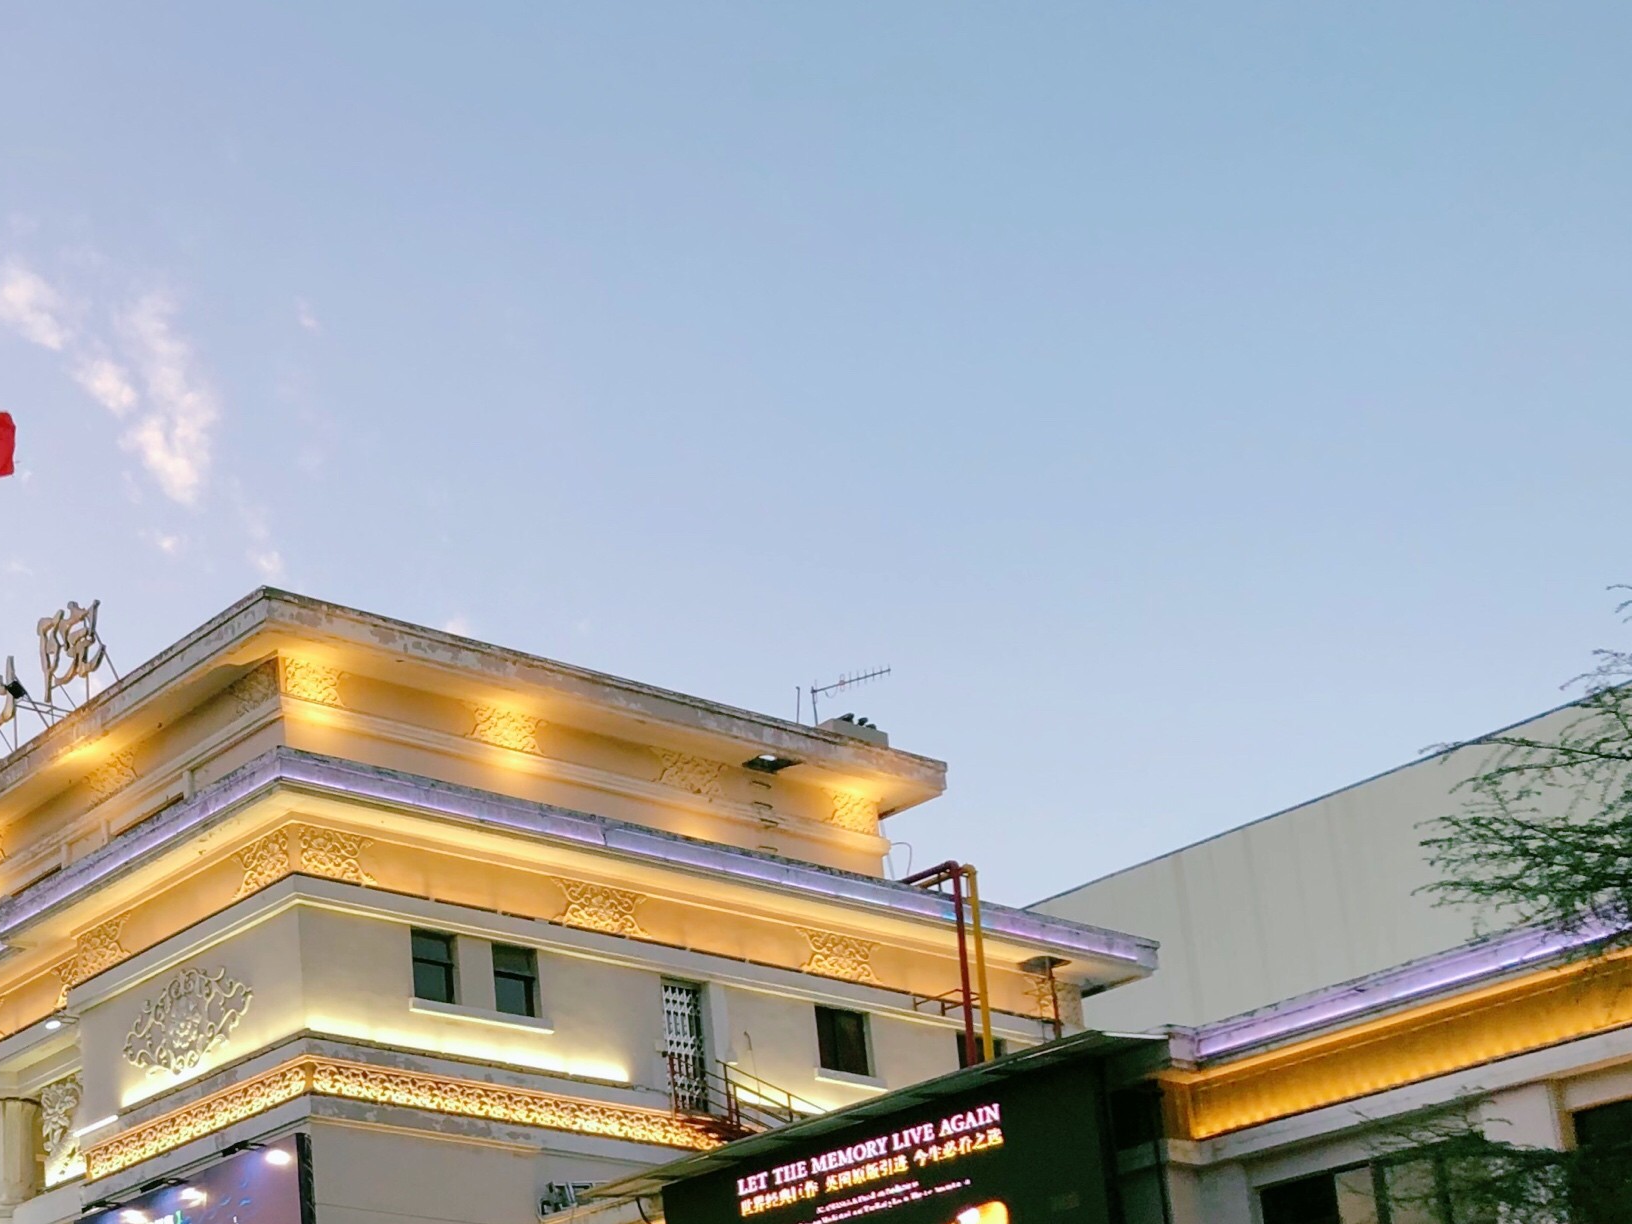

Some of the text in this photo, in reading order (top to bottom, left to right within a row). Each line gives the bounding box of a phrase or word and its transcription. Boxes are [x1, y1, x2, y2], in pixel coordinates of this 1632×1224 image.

[736, 1102, 1001, 1196] LET THE MEMORY LIVE AGAIN
